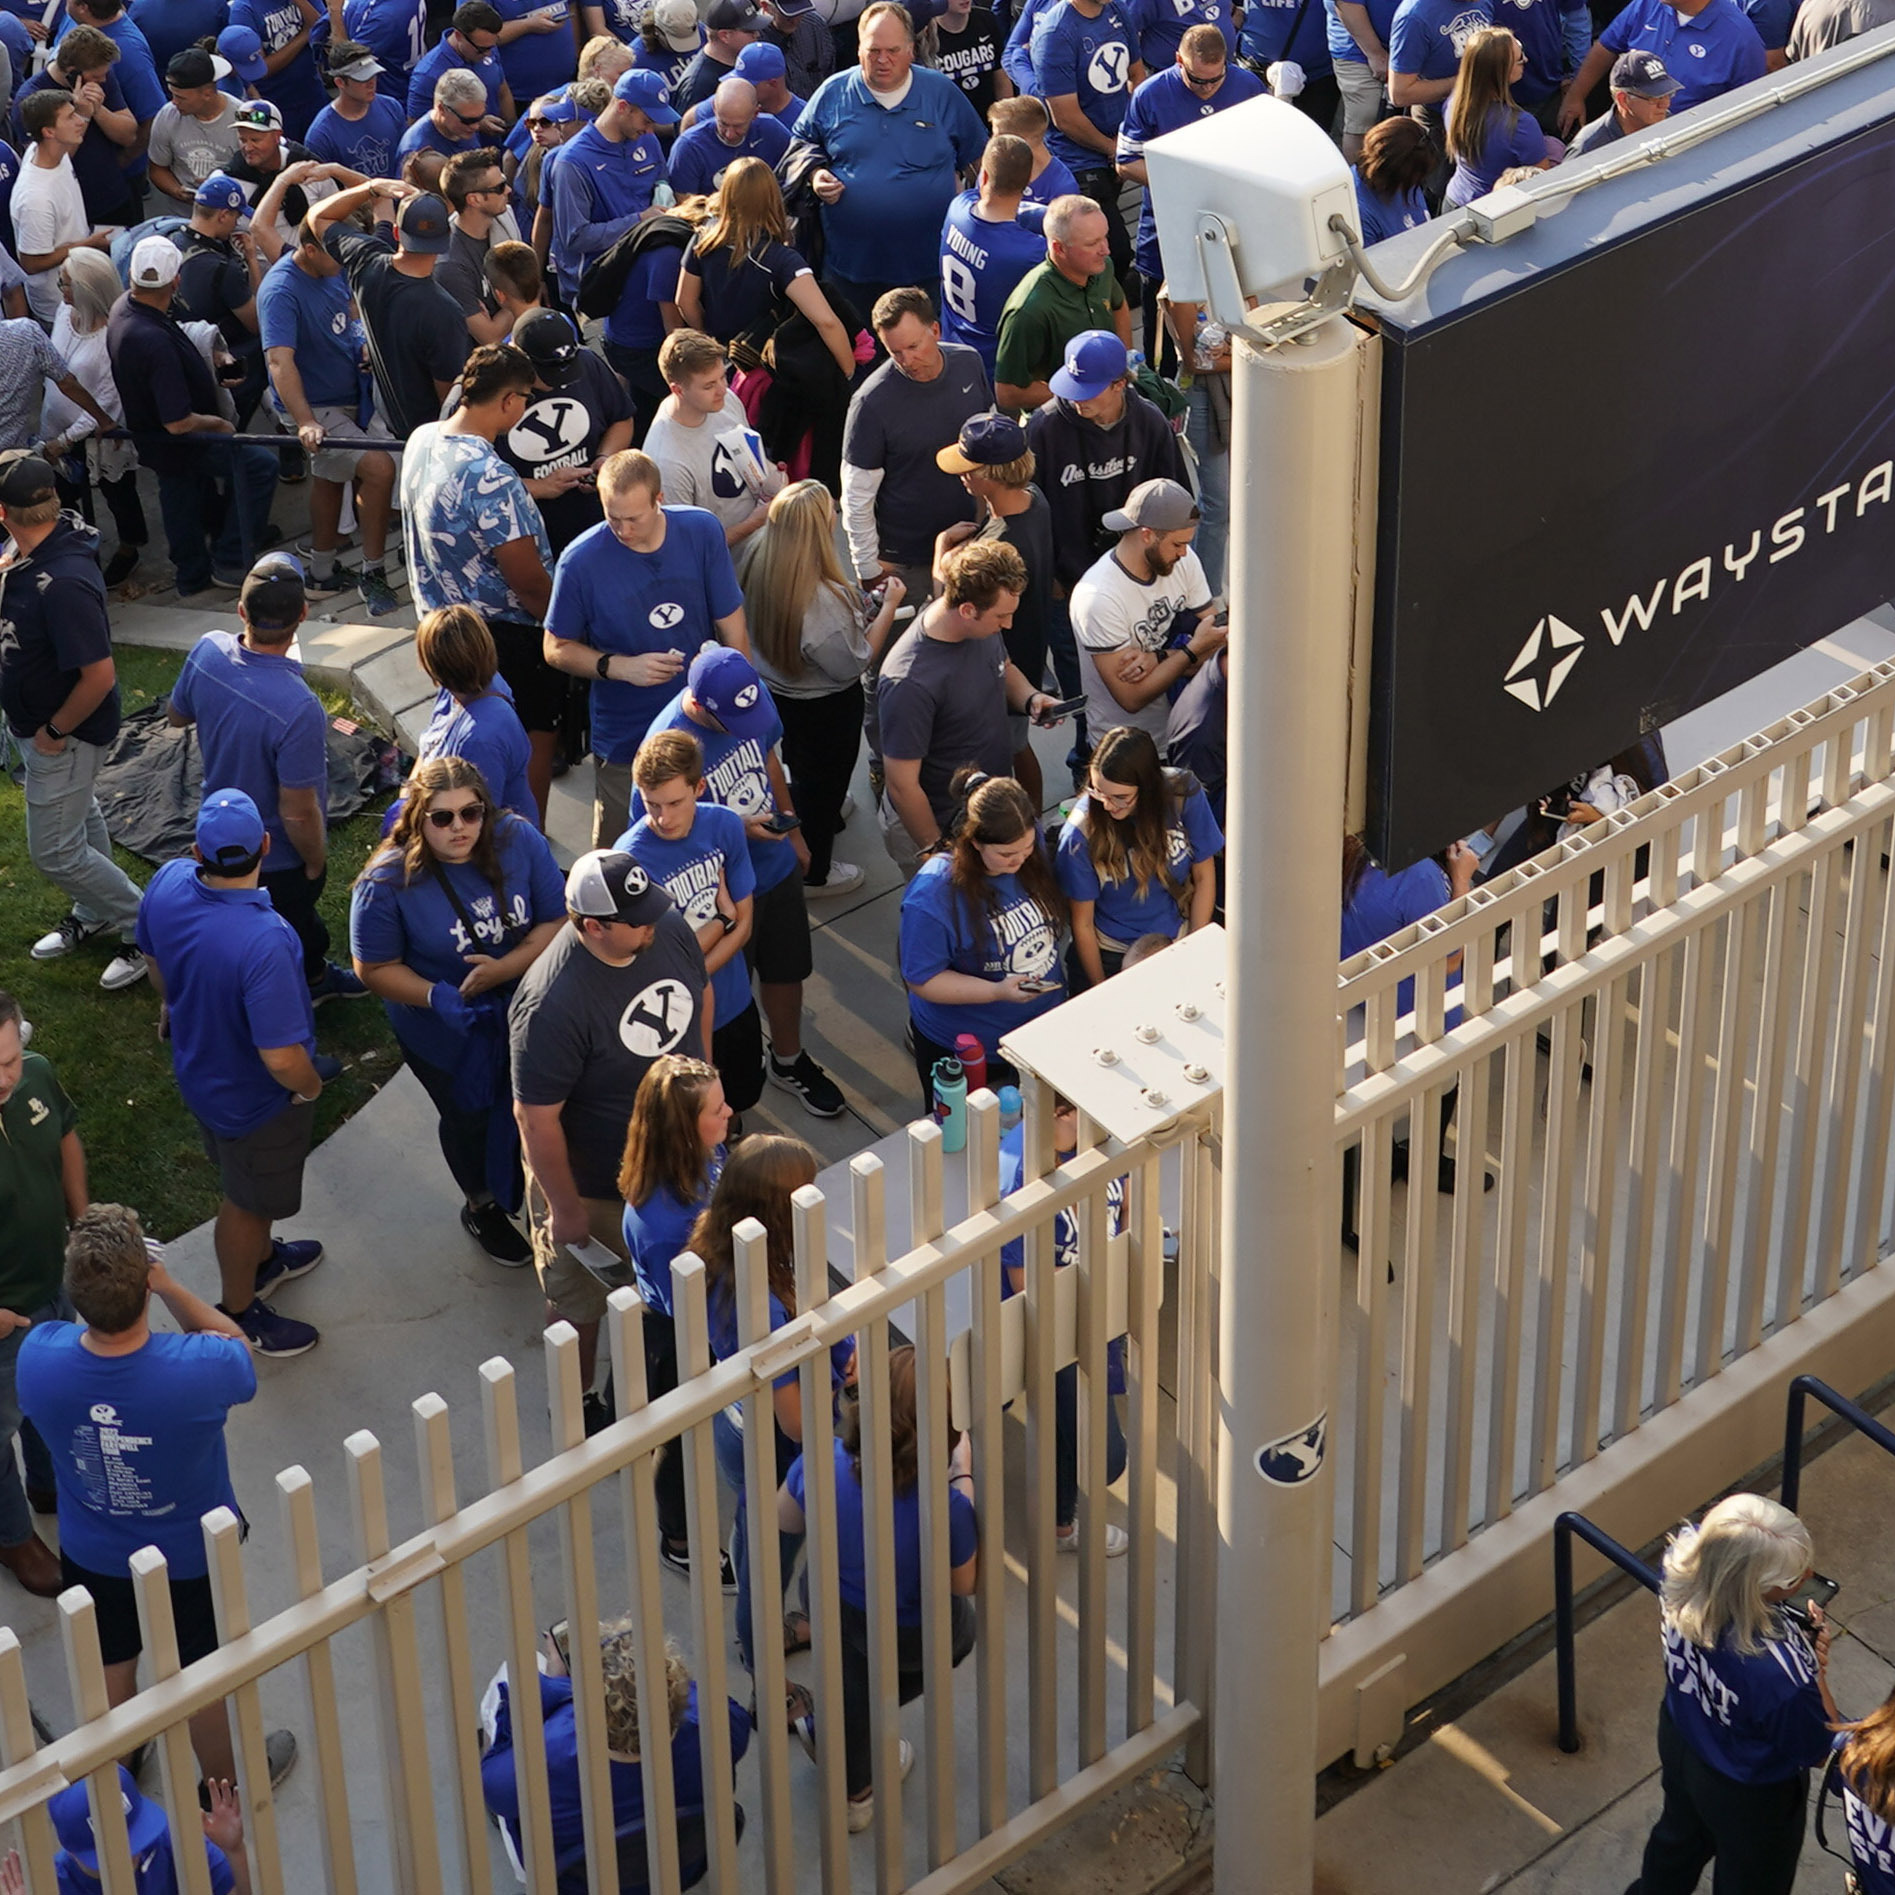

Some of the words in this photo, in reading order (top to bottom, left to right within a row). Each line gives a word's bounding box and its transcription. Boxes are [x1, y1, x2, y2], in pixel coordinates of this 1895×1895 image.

[937, 44, 995, 71] COUGARS
[945, 224, 989, 271] YOUNG
[942, 254, 977, 325] 8
[706, 738, 765, 805] FOOTBALL
[665, 854, 722, 908] FOOTBA
[989, 898, 1048, 957] FOOTB
